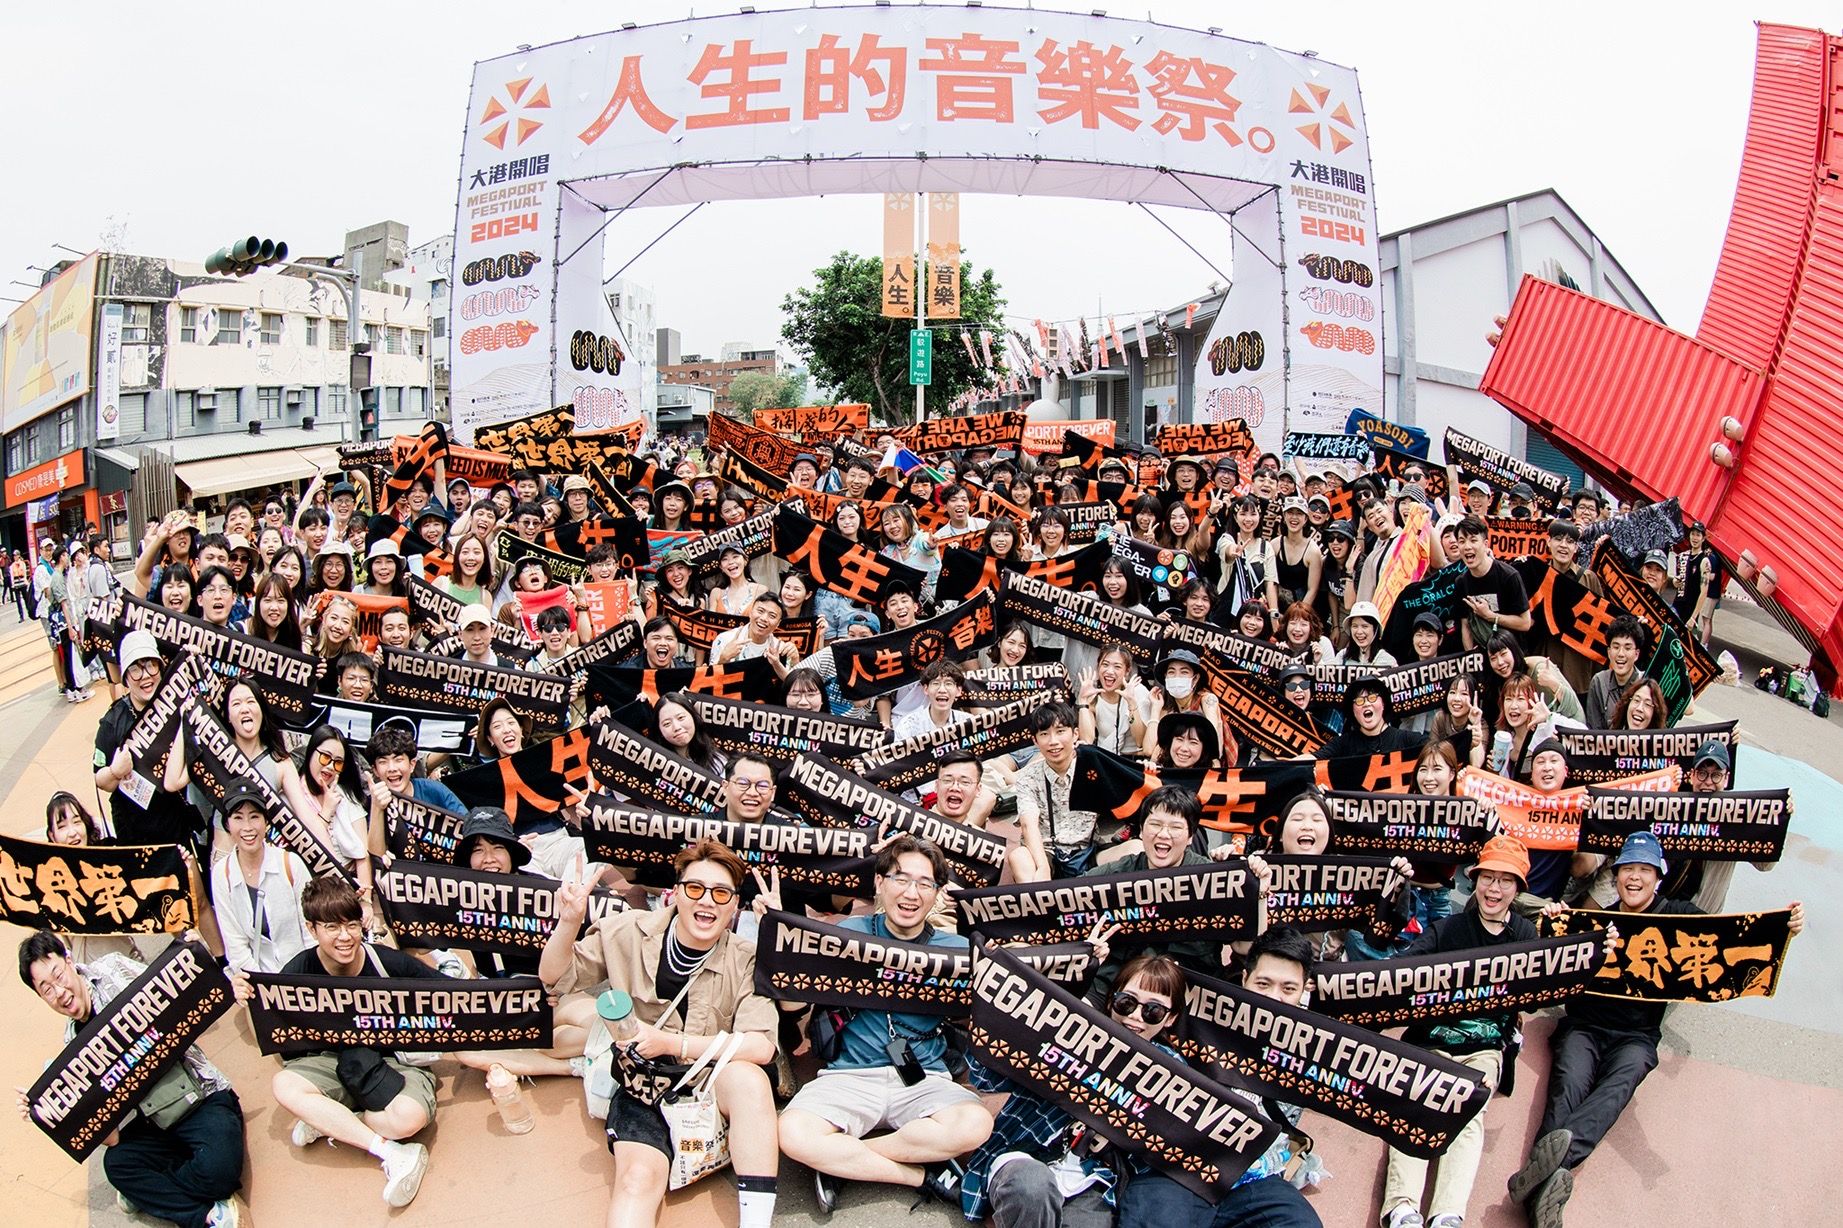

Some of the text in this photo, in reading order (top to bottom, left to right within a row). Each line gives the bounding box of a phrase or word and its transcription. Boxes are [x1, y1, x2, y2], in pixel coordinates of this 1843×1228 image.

[577, 32, 1275, 154] 人生的音樂祭。
[470, 153, 550, 191] 大港開唱
[1290, 159, 1367, 195] 大港開唱
[467, 180, 547, 208] MEGAPORT
[471, 195, 542, 219] FESTIVAL
[1290, 185, 1367, 211] MEGAPORT
[1297, 199, 1366, 223] FESTIVAL
[471, 213, 538, 244] 2024
[1301, 216, 1366, 247] 2024
[888, 263, 910, 314] 人生。
[934, 264, 956, 315] 音樂。
[1357, 418, 1415, 450] YOASOBI
[514, 438, 629, 472] 世界第一
[1447, 431, 1563, 493] MEGAPORT FOREVER
[1497, 520, 1538, 531] WARNING
[787, 525, 891, 606] 人生
[1009, 573, 1163, 641] MEGAPORT FOREVER
[1053, 605, 1108, 633] 15TH ANNIV.
[1403, 597, 1422, 609] THE
[1527, 566, 1620, 667] 人生
[125, 602, 228, 663] MEGAPORT
[227, 639, 314, 687] FOREVER
[387, 653, 566, 704] MEGAPORT FOREVER
[847, 647, 905, 689] 人生
[1421, 652, 1484, 682] FOREVER
[443, 682, 469, 697] 15TH
[986, 679, 1046, 691] 15TH ANNIV.
[1391, 684, 1443, 703] 15TH ANNIV.
[127, 656, 201, 758] MEGAPORT
[748, 732, 822, 753] 15TH ANNIV.
[796, 718, 886, 750] FOREVER
[862, 689, 1052, 770] MEGAPORT FOREVER
[931, 728, 1000, 759] 15TH ANNIV.
[1562, 734, 1650, 757] MEGAPORT
[596, 723, 708, 800] MEGAPORT
[1615, 757, 1641, 769] 15TH
[655, 777, 684, 799] 15TH
[789, 754, 905, 829] MEGAPORT
[908, 810, 1006, 869] FOREVER
[1527, 810, 1559, 824] 15TH
[1587, 796, 1694, 822] MEGAPORT
[1696, 798, 1785, 826] FOREVER
[750, 823, 869, 860] FOREVER
[1382, 824, 1461, 841] 15TH ANNIV.
[1649, 823, 1721, 837] 15TH ANNIV.
[376, 868, 519, 914] MEGAPORT
[963, 887, 1112, 926] MEGAPORT
[1117, 868, 1246, 906] FOREVER
[1301, 892, 1355, 907] ANNIV.
[456, 909, 498, 928] 15TH
[1056, 904, 1160, 928] 15TH ANNIV.
[775, 922, 947, 977] MEGAPORT
[876, 967, 923, 985] 15TH
[1317, 941, 1594, 1002] MEGAPORT FOREVER
[258, 983, 541, 1015] MEGAPORT FOREVER
[1409, 984, 1508, 1007] 15TH ANNIV.
[34, 947, 204, 1129] MEGAPORT FOREVER
[353, 1015, 456, 1030] 15TH ANNIV.
[100, 1026, 164, 1092] 15TH ANNIV.
[972, 952, 1264, 1155] MEGAPORT FOREVER
[1184, 983, 1477, 1115] MEGAPORT FOREVER
[1037, 1042, 1147, 1120] 15TH ANNIV.
[1260, 1045, 1366, 1100] 15TH ANNIV.
